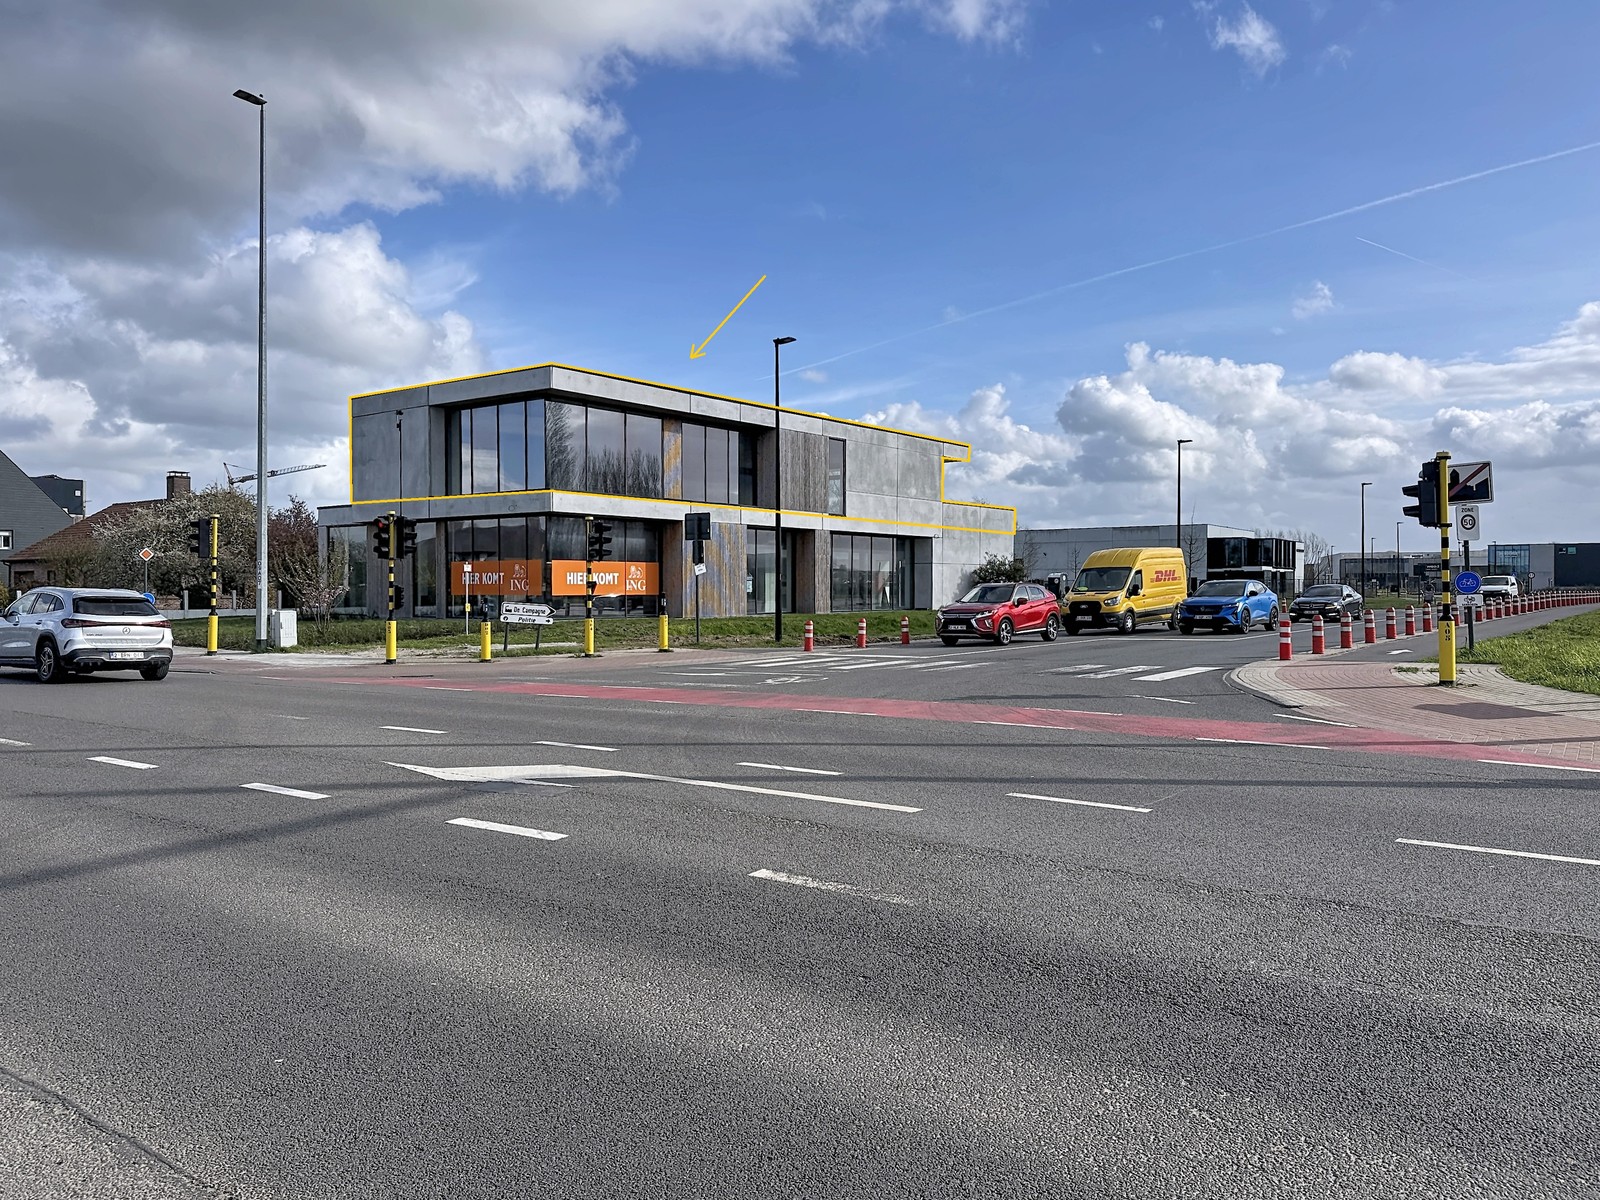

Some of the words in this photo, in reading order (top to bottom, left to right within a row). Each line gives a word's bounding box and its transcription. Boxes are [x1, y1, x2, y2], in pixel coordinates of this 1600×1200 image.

[1464, 518, 1474, 526] 50
[482, 572, 504, 585] KOMT
[592, 572, 619, 585] KOMT
[1155, 570, 1178, 582] DHL
[510, 579, 529, 591] ING
[626, 580, 646, 591] ING
[522, 606, 546, 615] Campagne
